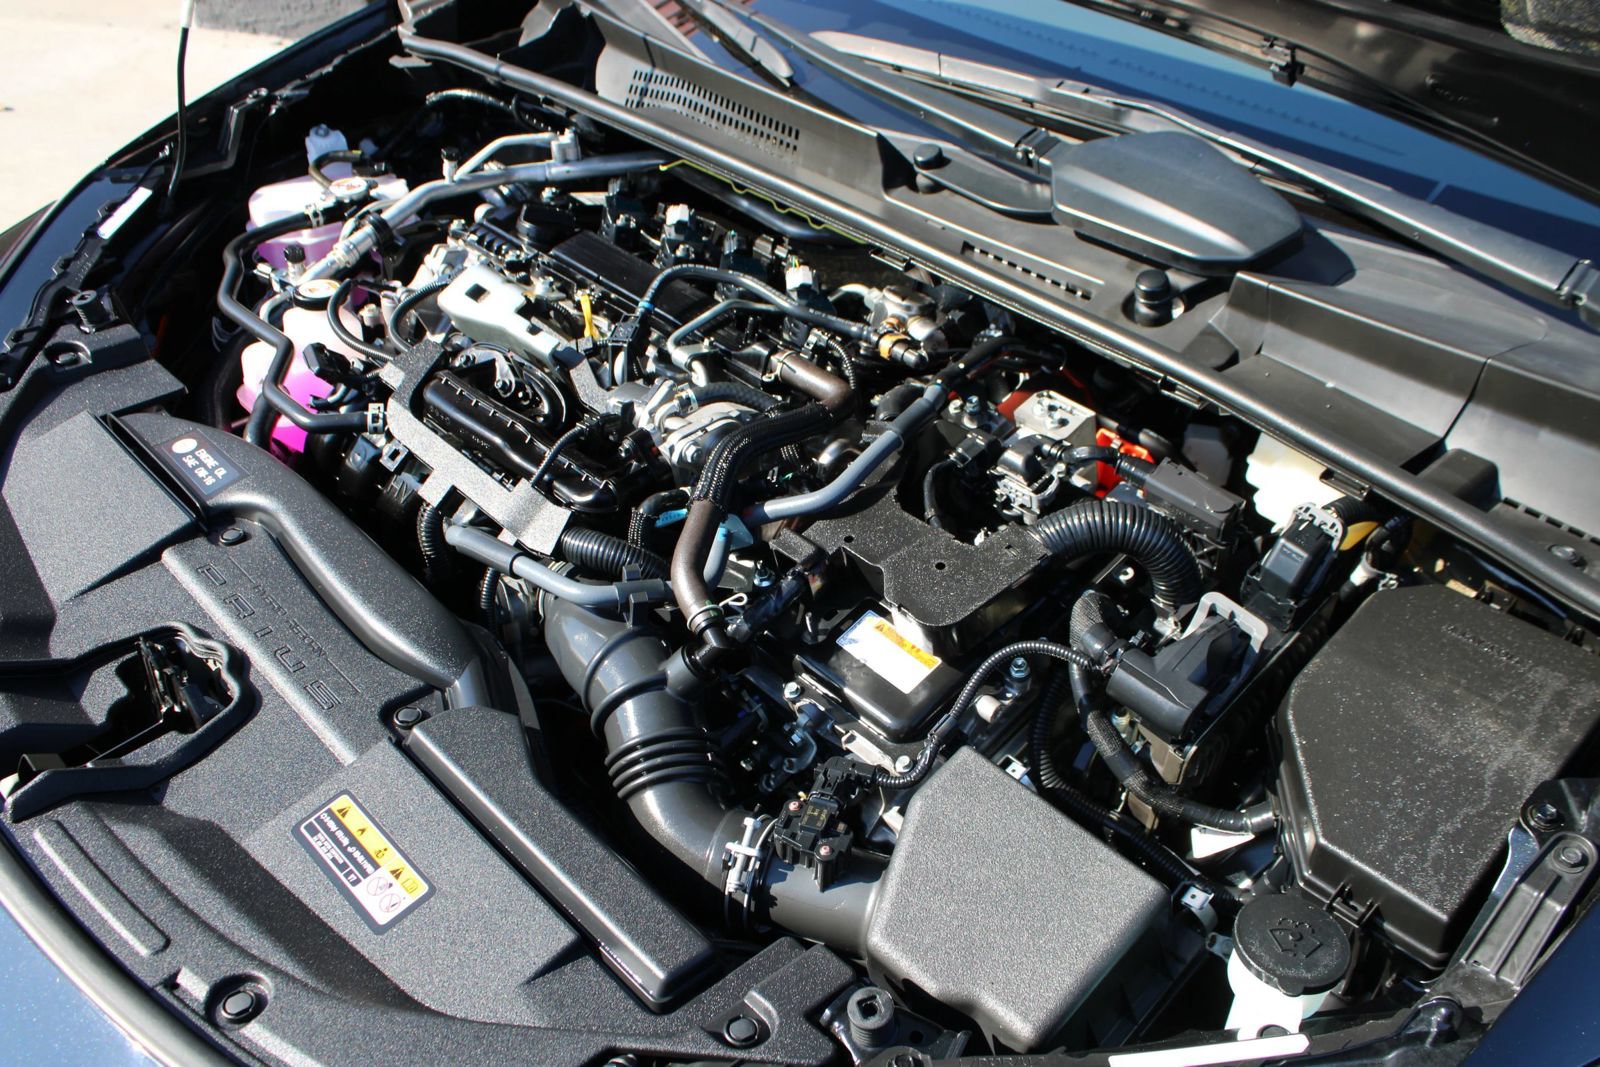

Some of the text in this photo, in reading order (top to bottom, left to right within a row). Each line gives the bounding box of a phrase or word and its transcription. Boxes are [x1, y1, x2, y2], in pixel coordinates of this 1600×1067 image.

[182, 454, 199, 468] SAE
[213, 467, 227, 479] OIL
[252, 583, 288, 617] HYBRID
[197, 562, 342, 711] PRIUS
